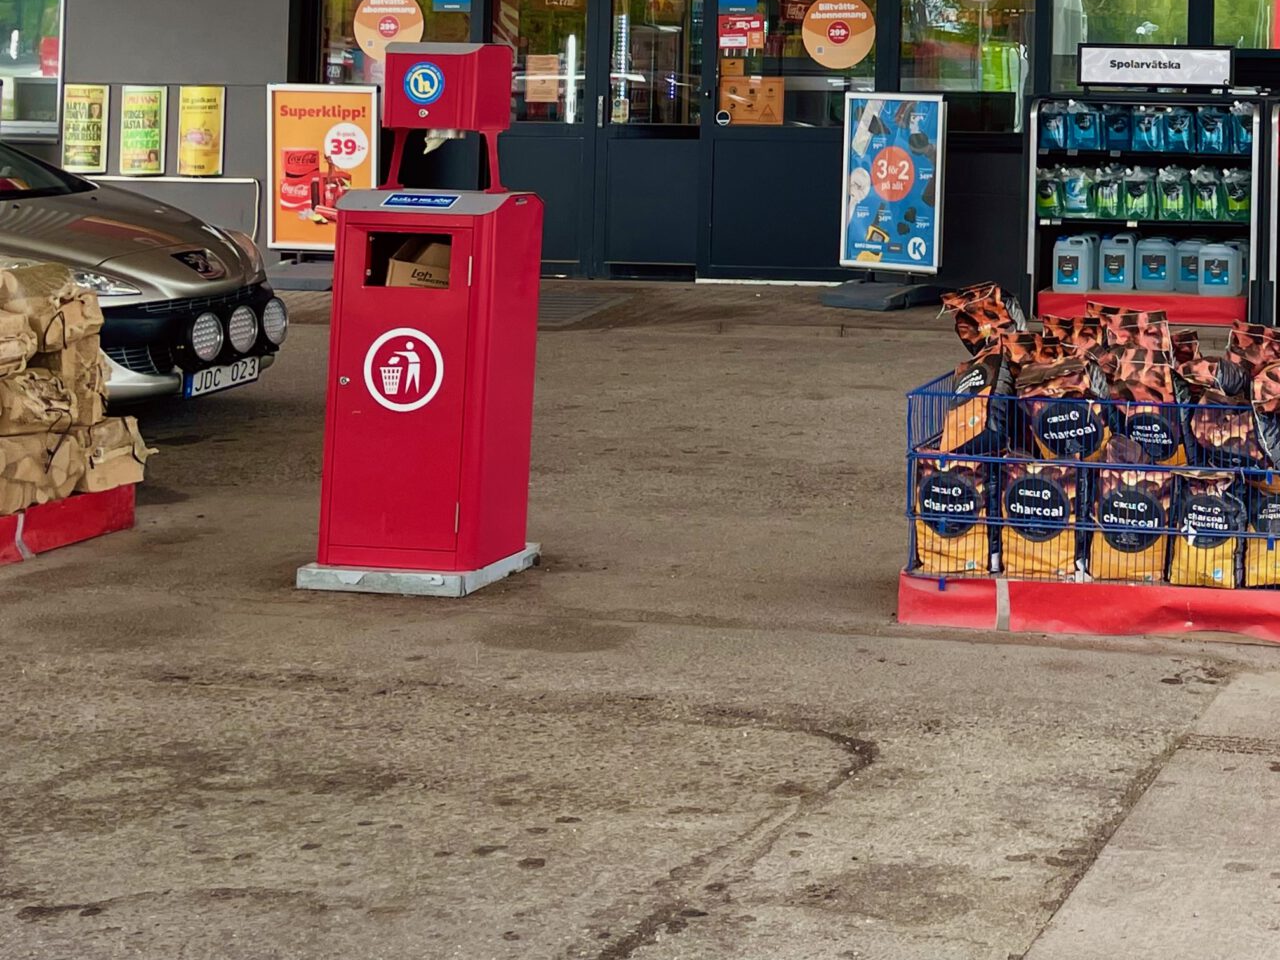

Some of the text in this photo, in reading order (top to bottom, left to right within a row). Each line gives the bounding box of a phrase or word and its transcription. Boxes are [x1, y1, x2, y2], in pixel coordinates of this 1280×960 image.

[362, 5, 416, 15] abonnemang
[818, 2, 859, 11] Biltvätts-
[810, 11, 867, 20] abonnemang
[1109, 60, 1181, 70] Spolarvätska
[280, 105, 366, 121] Superklipp!
[876, 159, 910, 181] 3 för 2
[881, 179, 891, 192] på
[910, 240, 925, 259] K
[194, 358, 256, 392] JDC 023
[1043, 424, 1097, 440] charcoal
[923, 497, 974, 512] charcoal
[1010, 502, 1063, 517] charcoal
[1103, 514, 1159, 528] charcoal
[1187, 512, 1226, 523] charcoal
